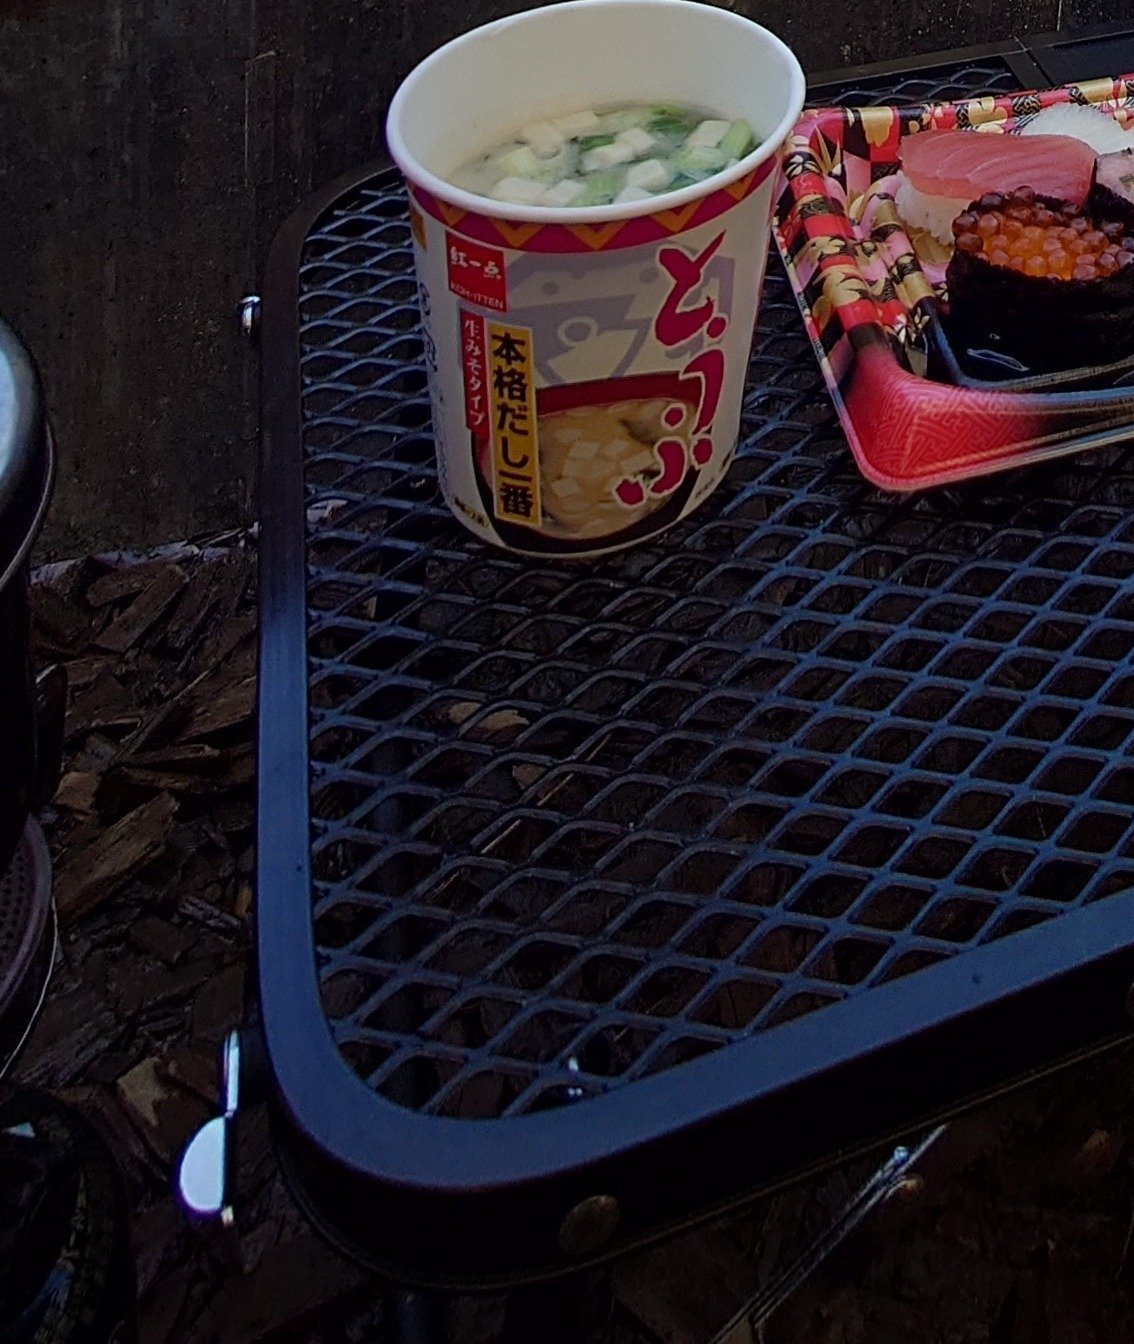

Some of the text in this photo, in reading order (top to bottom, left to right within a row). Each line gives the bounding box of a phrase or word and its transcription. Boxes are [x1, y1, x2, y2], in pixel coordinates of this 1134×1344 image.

[450, 246, 502, 281] 紅一点
[465, 320, 485, 427] 生みそタイプ
[491, 332, 534, 517] 本格だし一番
[616, 230, 727, 506] とうふ
